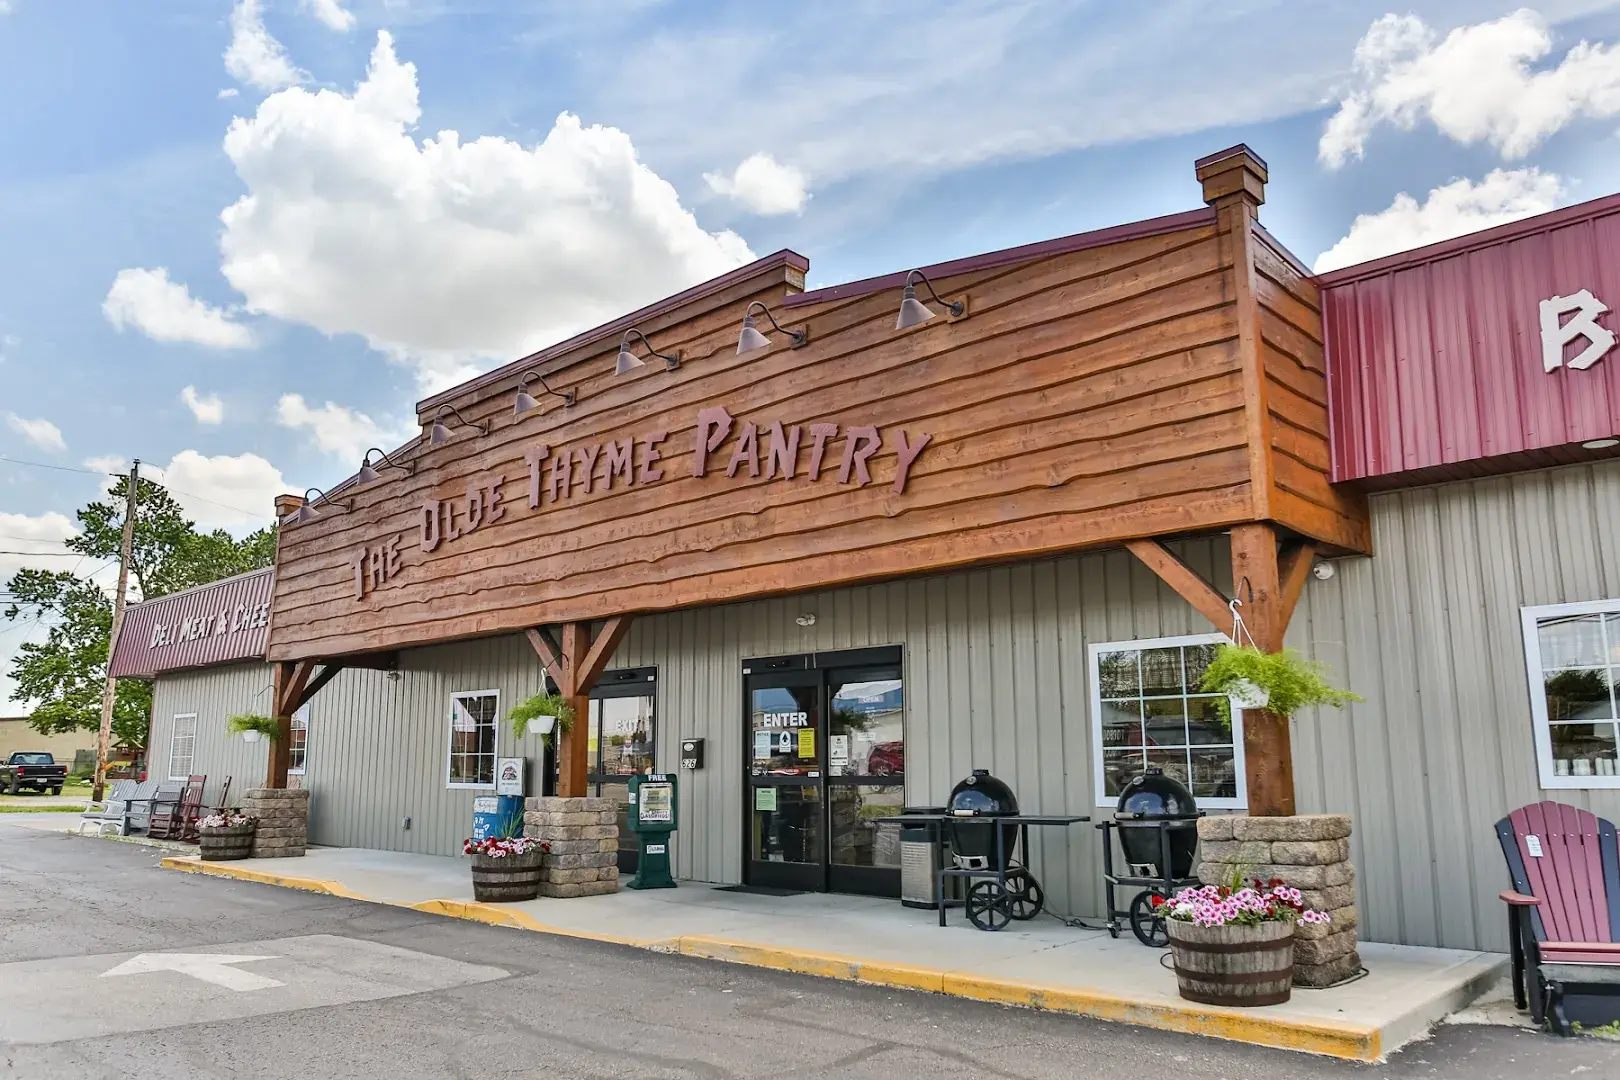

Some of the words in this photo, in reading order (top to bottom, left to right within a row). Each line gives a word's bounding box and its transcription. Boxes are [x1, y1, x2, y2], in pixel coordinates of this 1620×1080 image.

[351, 534, 402, 601] THE
[419, 476, 505, 554] OLDE
[525, 430, 670, 509] THYME
[692, 406, 933, 494] PANTRY
[150, 623, 179, 650] DELI
[180, 615, 216, 644] MEAT
[216, 608, 228, 636] &
[231, 602, 272, 633] CHEE
[615, 719, 638, 732] EXIT
[763, 711, 807, 727] ENTER
[648, 774, 667, 782] FREE
